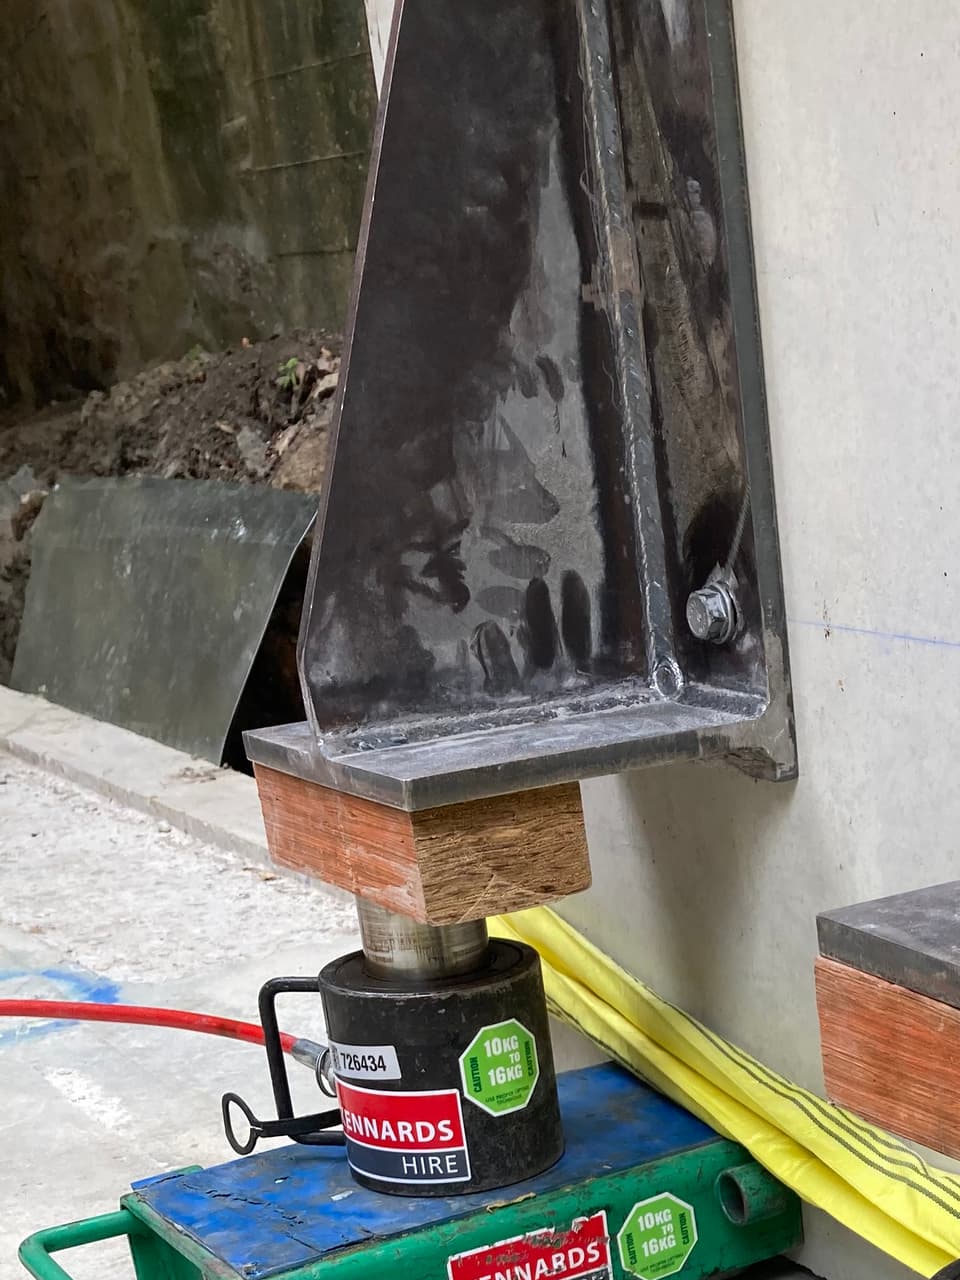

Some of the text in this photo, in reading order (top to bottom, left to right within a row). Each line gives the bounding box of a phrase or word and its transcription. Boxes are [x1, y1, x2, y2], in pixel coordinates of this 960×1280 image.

[484, 1035, 519, 1057] 10KG
[340, 1053, 387, 1072] 726434
[509, 1052, 521, 1064] TO
[469, 1056, 482, 1093] CAUTION
[488, 1064, 523, 1086] 16KG
[402, 1154, 459, 1175] HIRE
[638, 1208, 673, 1232] 10KG
[662, 1223, 674, 1235] TO
[678, 1212, 690, 1245] CAUTION
[625, 1232, 638, 1265] CAUTION
[642, 1235, 677, 1257] 16KG
